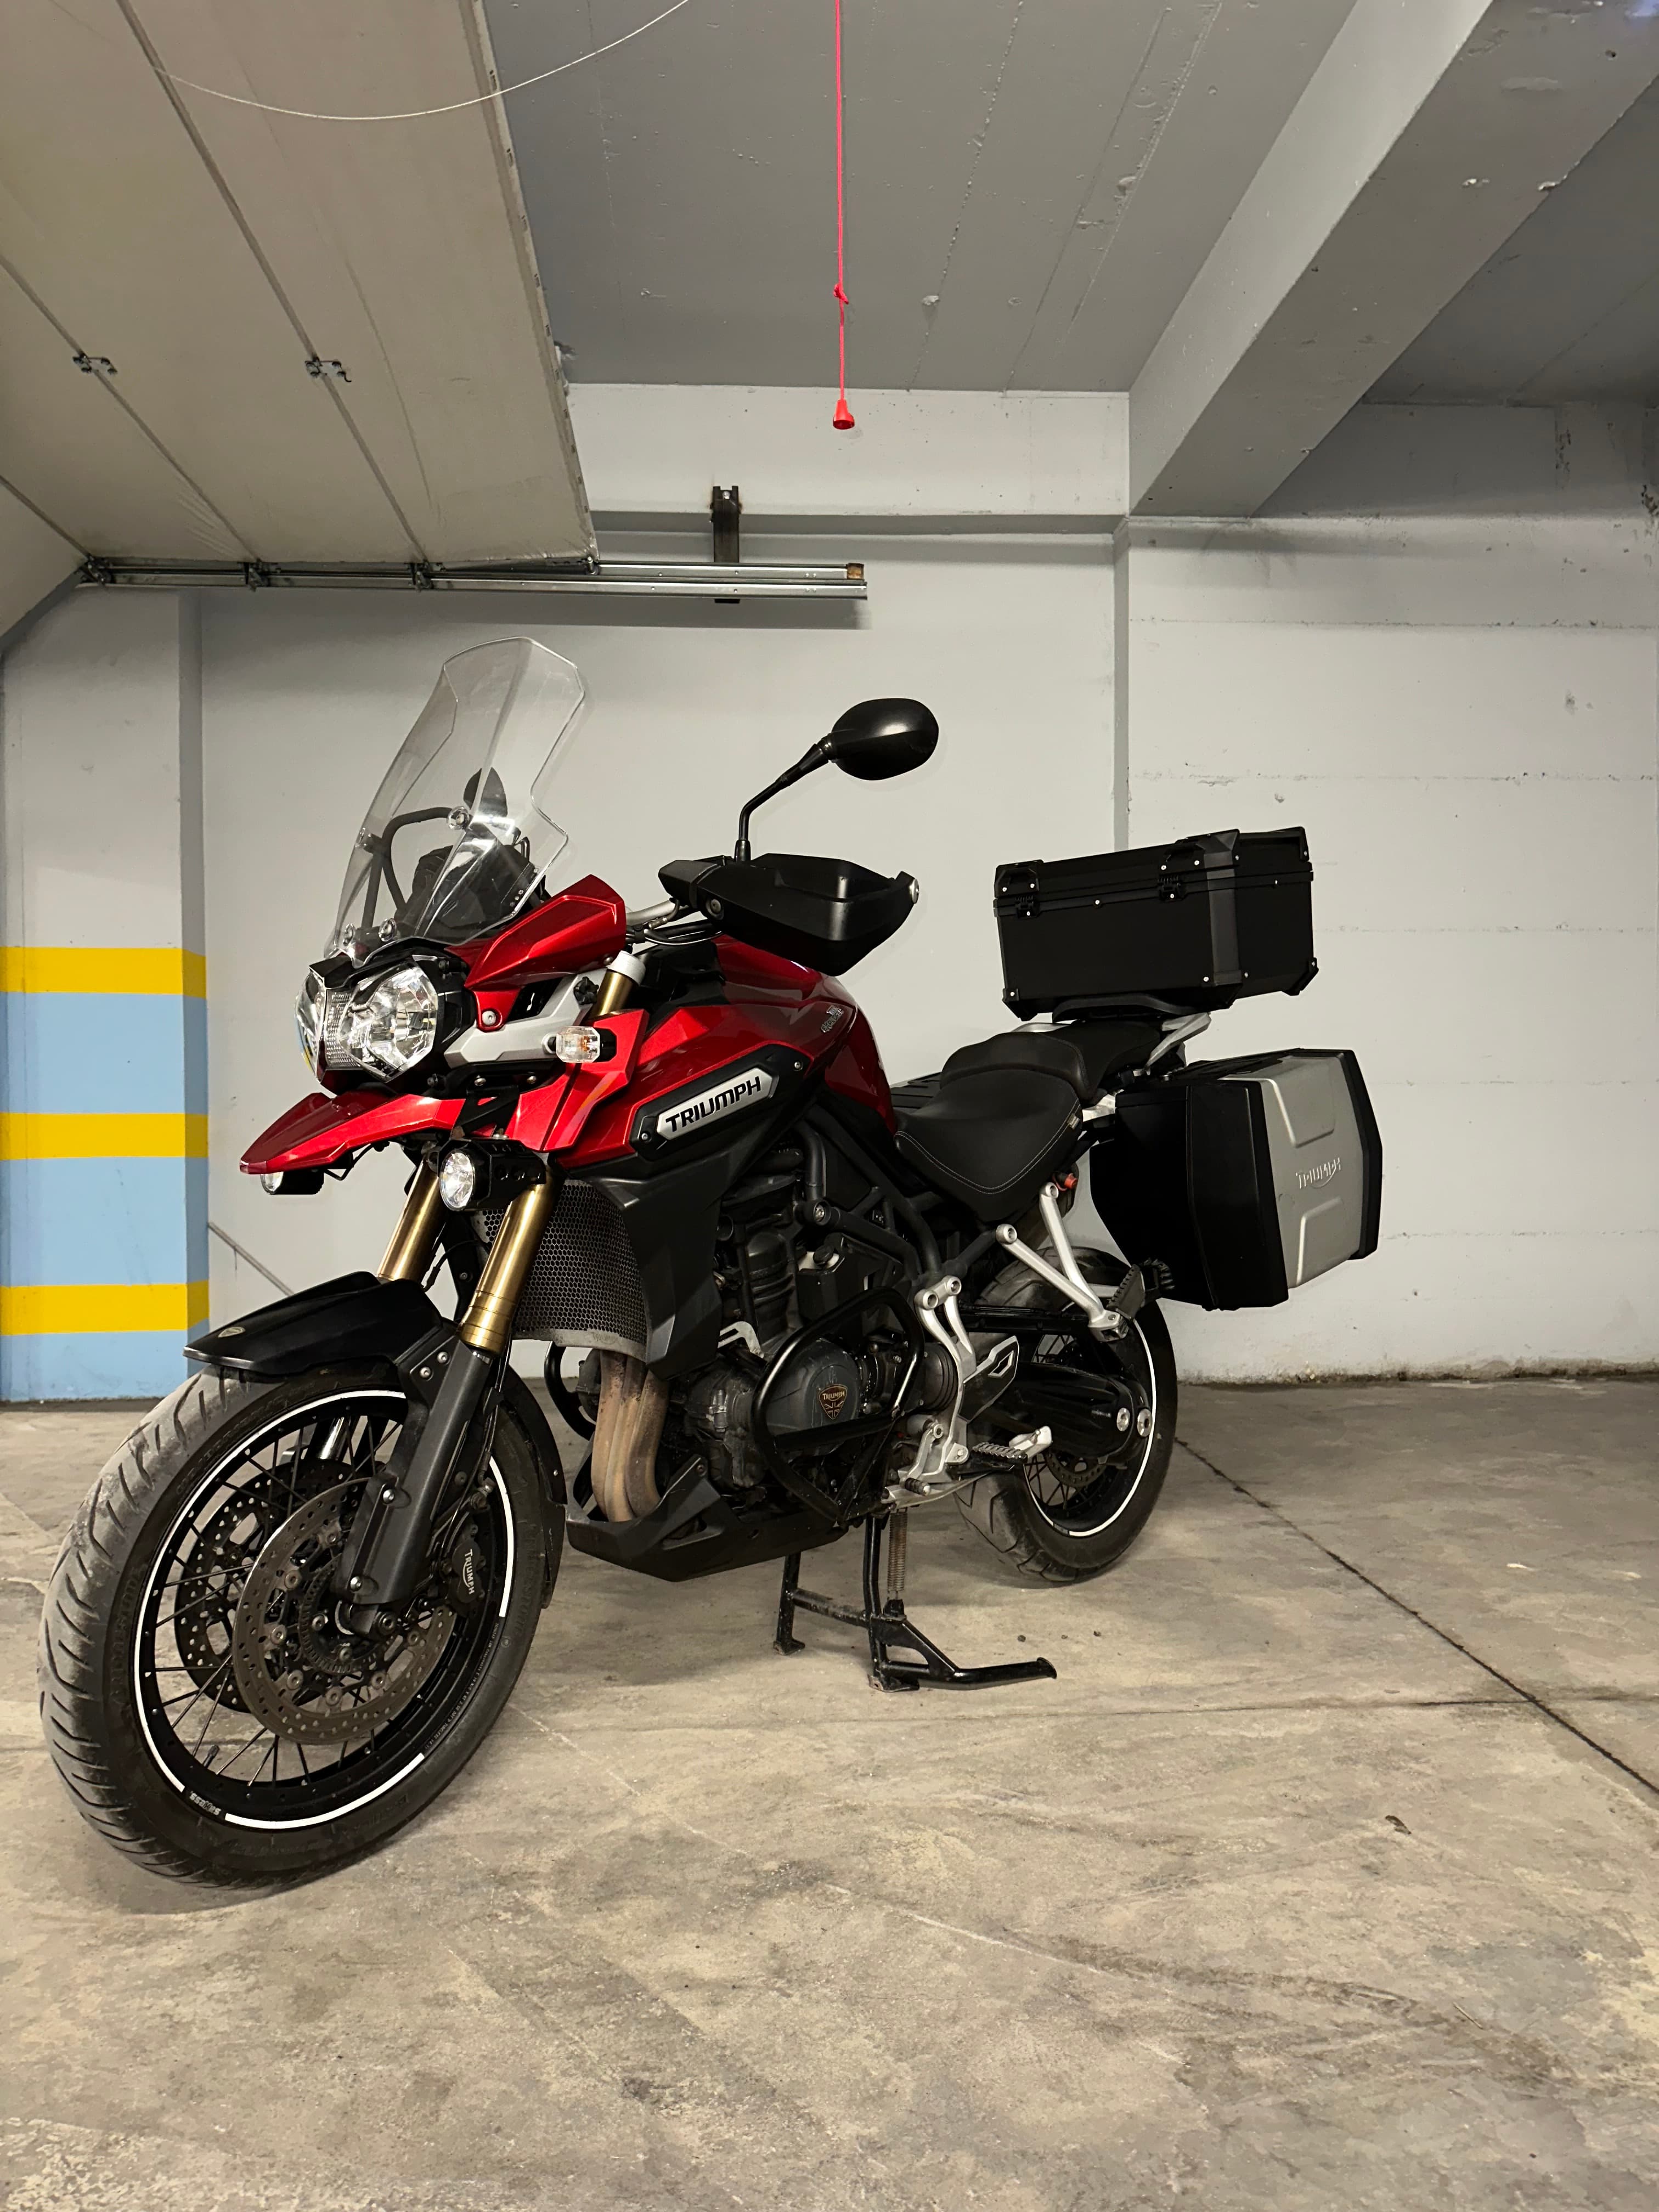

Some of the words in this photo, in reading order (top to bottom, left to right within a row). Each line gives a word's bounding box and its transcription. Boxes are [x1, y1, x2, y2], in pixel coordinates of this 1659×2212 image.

[665, 1075, 761, 1132] TRIUMPH
[1295, 1157, 1341, 1189] TRIUMPH
[822, 1391, 845, 1401] TRIUMPH
[463, 1549, 475, 1595] TRIUMPH
